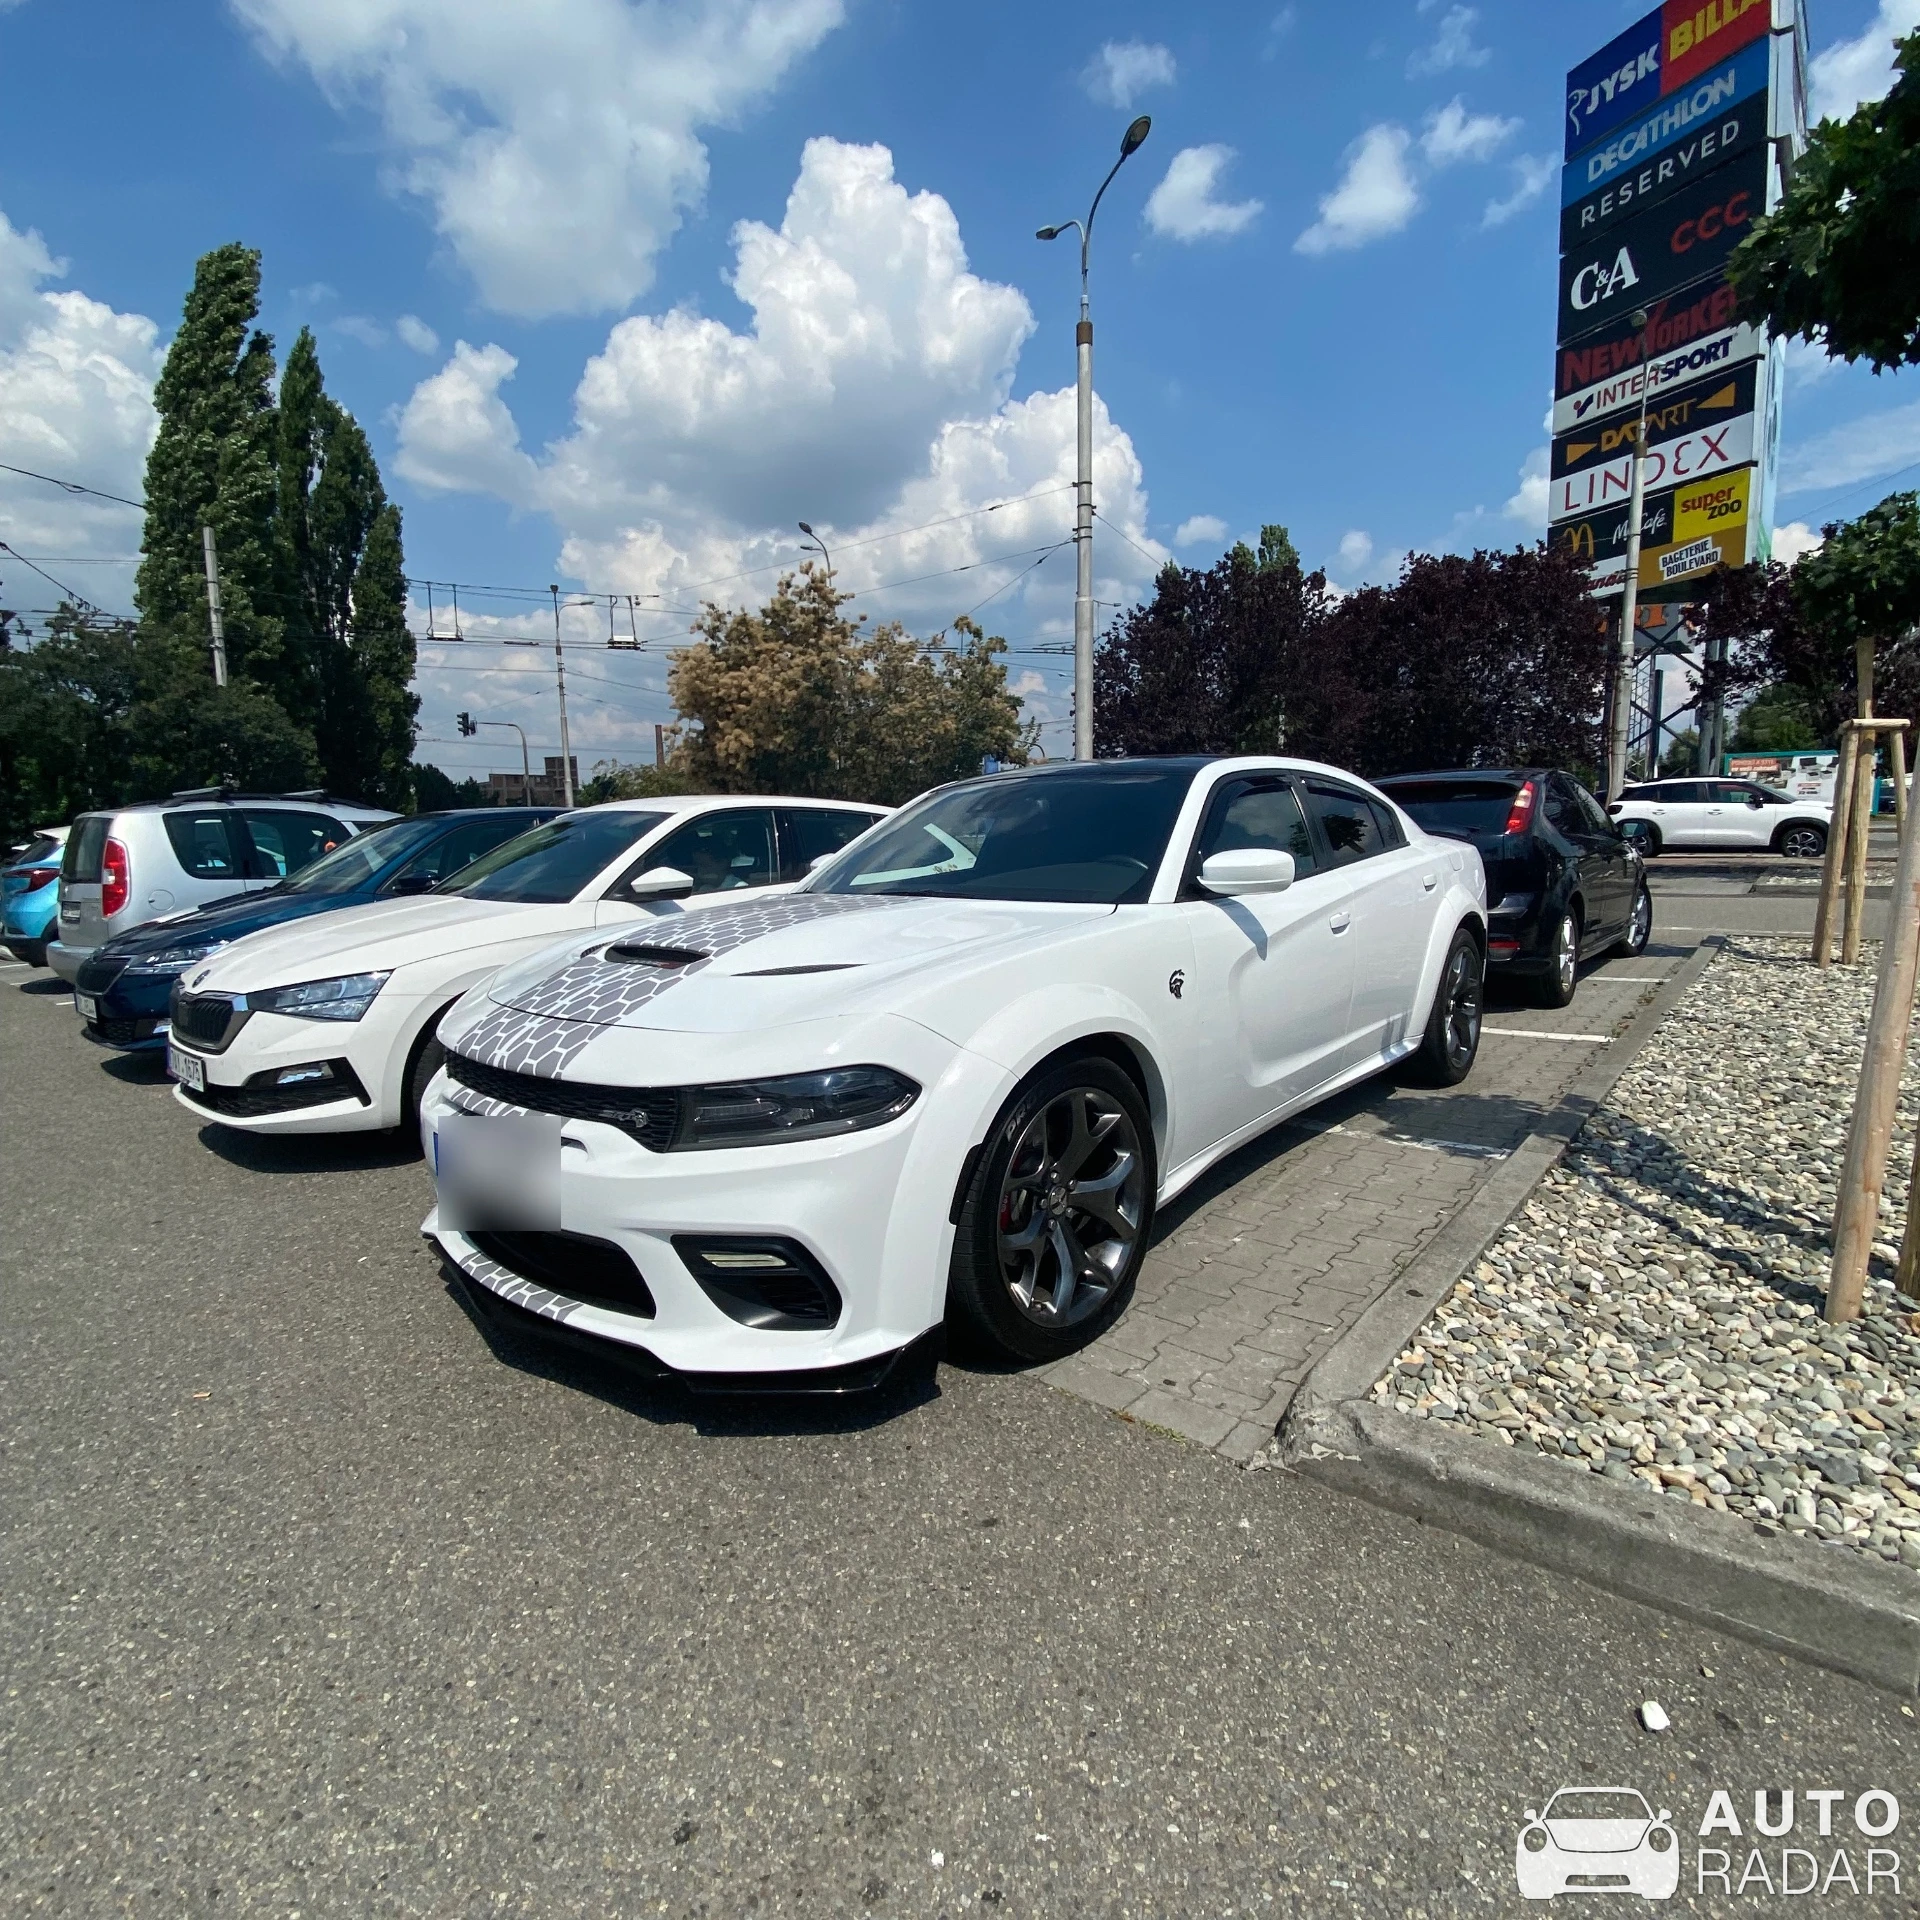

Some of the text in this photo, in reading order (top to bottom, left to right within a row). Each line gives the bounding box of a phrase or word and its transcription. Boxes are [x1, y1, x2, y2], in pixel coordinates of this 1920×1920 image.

[1669, 0, 1761, 62] BILL
[1585, 43, 1660, 116] JYSK
[1587, 68, 1735, 183] DECATHLON
[1580, 120, 1740, 229] RESERVED
[1670, 190, 1749, 255] CCC
[1570, 246, 1640, 311] C&A
[1596, 335, 1733, 410] INTERSPORT
[1564, 426, 1730, 512] LINDEX
[1680, 485, 1736, 514] super
[1661, 539, 1710, 568] BAGETERIE
[1666, 550, 1719, 578] BOULEVARD
